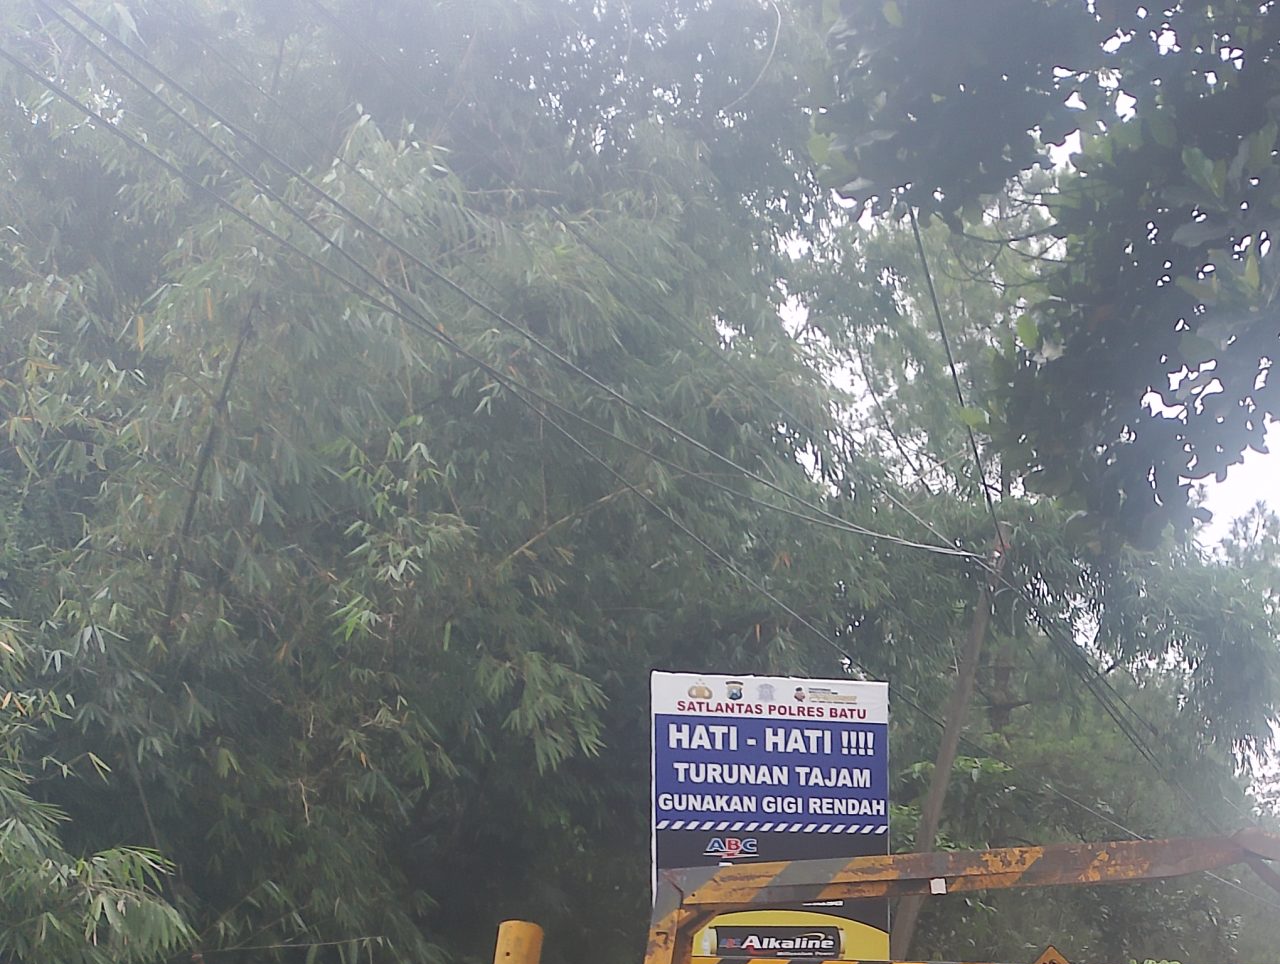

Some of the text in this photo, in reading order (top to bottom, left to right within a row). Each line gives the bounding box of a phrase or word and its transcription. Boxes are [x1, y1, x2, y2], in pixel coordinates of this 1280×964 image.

[677, 700, 867, 720] SATLANTAS POLRES BATU
[668, 723, 738, 751] HATI
[765, 727, 832, 755] HATI
[841, 730, 874, 756] !!!!
[673, 762, 871, 788] TURUNAN TAJAM
[658, 793, 885, 816] GUNAKAN GIGI RENDAH
[706, 838, 758, 852] ABC
[741, 935, 834, 949] Alkaline
